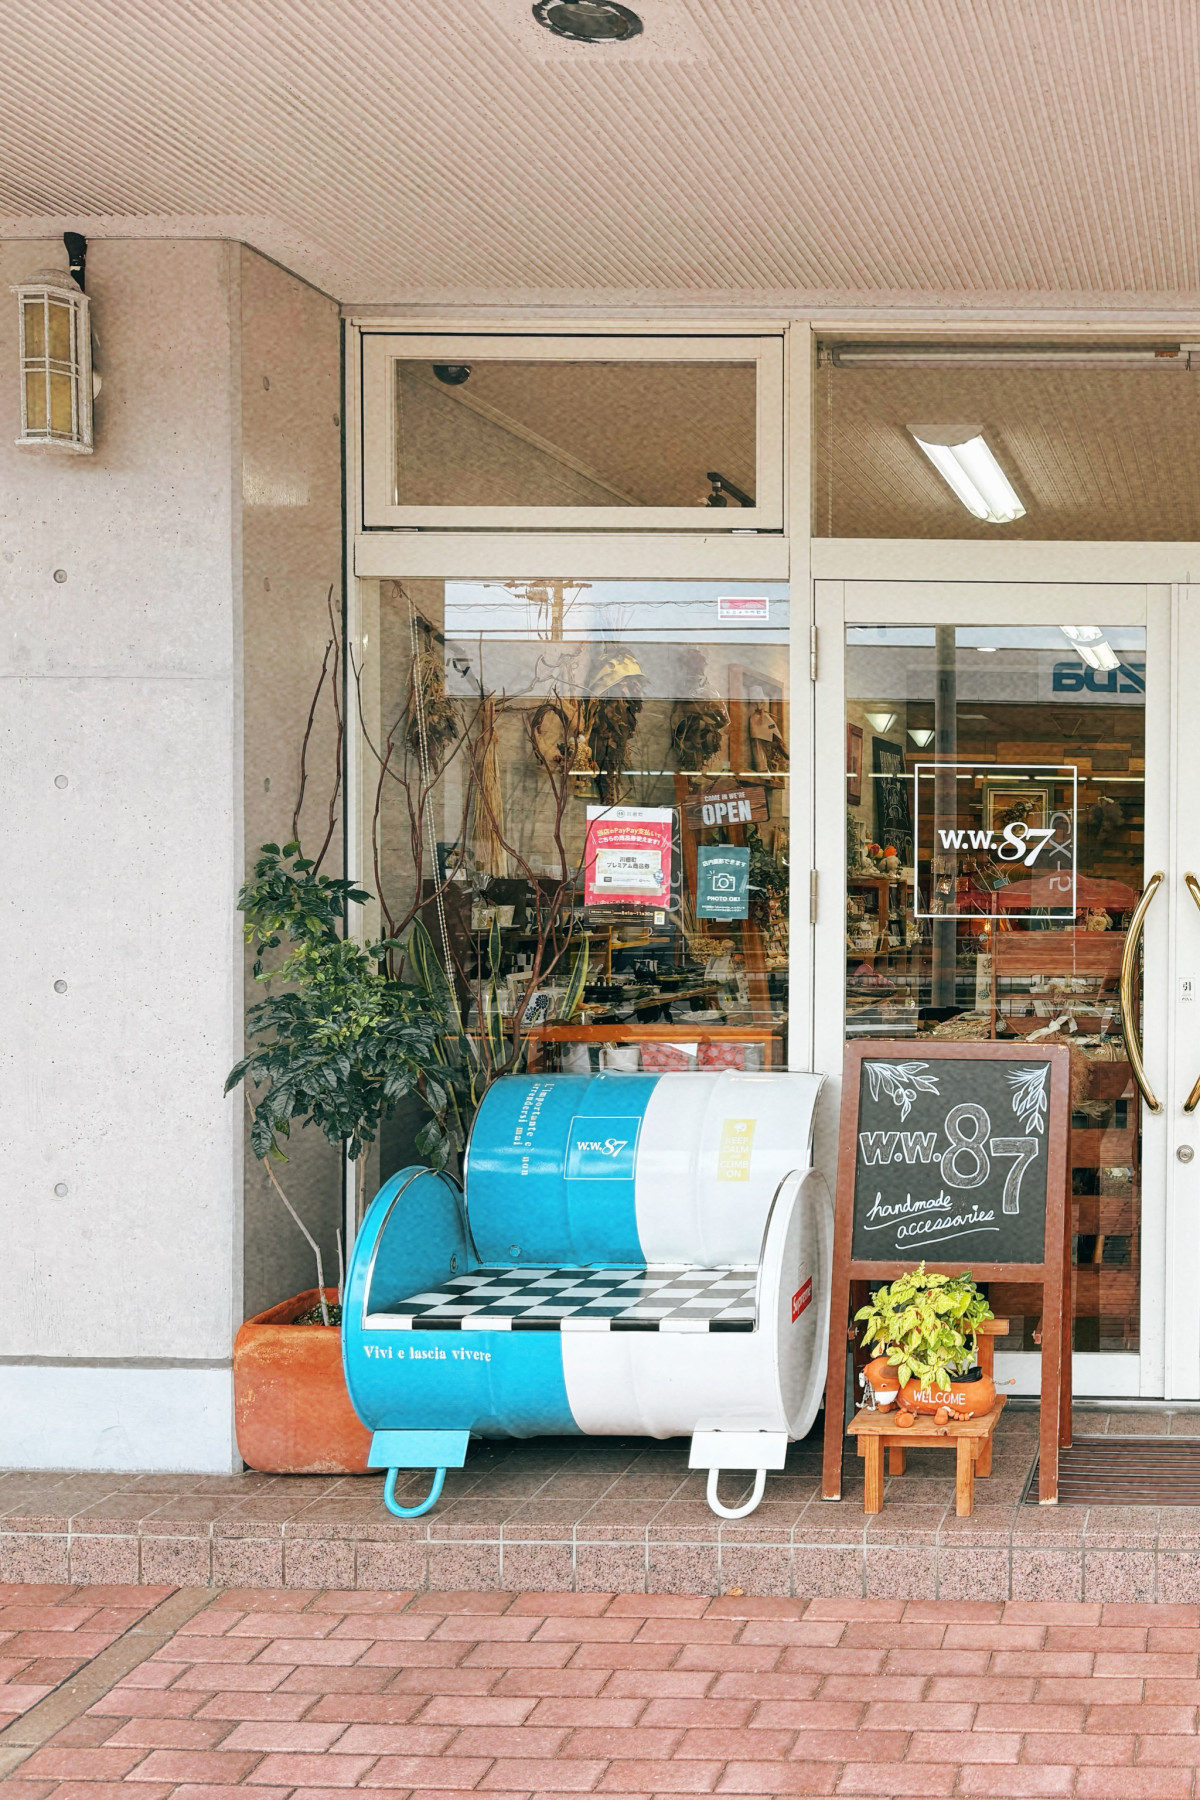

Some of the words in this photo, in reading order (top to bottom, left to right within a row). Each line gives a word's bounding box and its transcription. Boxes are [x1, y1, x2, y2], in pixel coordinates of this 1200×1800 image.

[704, 793, 720, 802] COME
[722, 793, 728, 801] IN
[729, 791, 746, 800] WE'RE
[702, 800, 752, 825] OPEN
[1182, 981, 1192, 992] 引
[518, 1083, 538, 1123] arrendersi
[526, 1083, 555, 1137] L'importante
[513, 1127, 523, 1146] mai
[521, 1156, 530, 1176] non
[726, 1169, 742, 1177] ON
[866, 1190, 953, 1221] handmade
[896, 1204, 996, 1239] accessories
[793, 1285, 812, 1314] Supreme
[363, 1345, 393, 1359] Vivi
[398, 1349, 405, 1359] e
[409, 1346, 447, 1360] lascia
[452, 1347, 492, 1362] vivere
[913, 1389, 967, 1405] WELCOME
